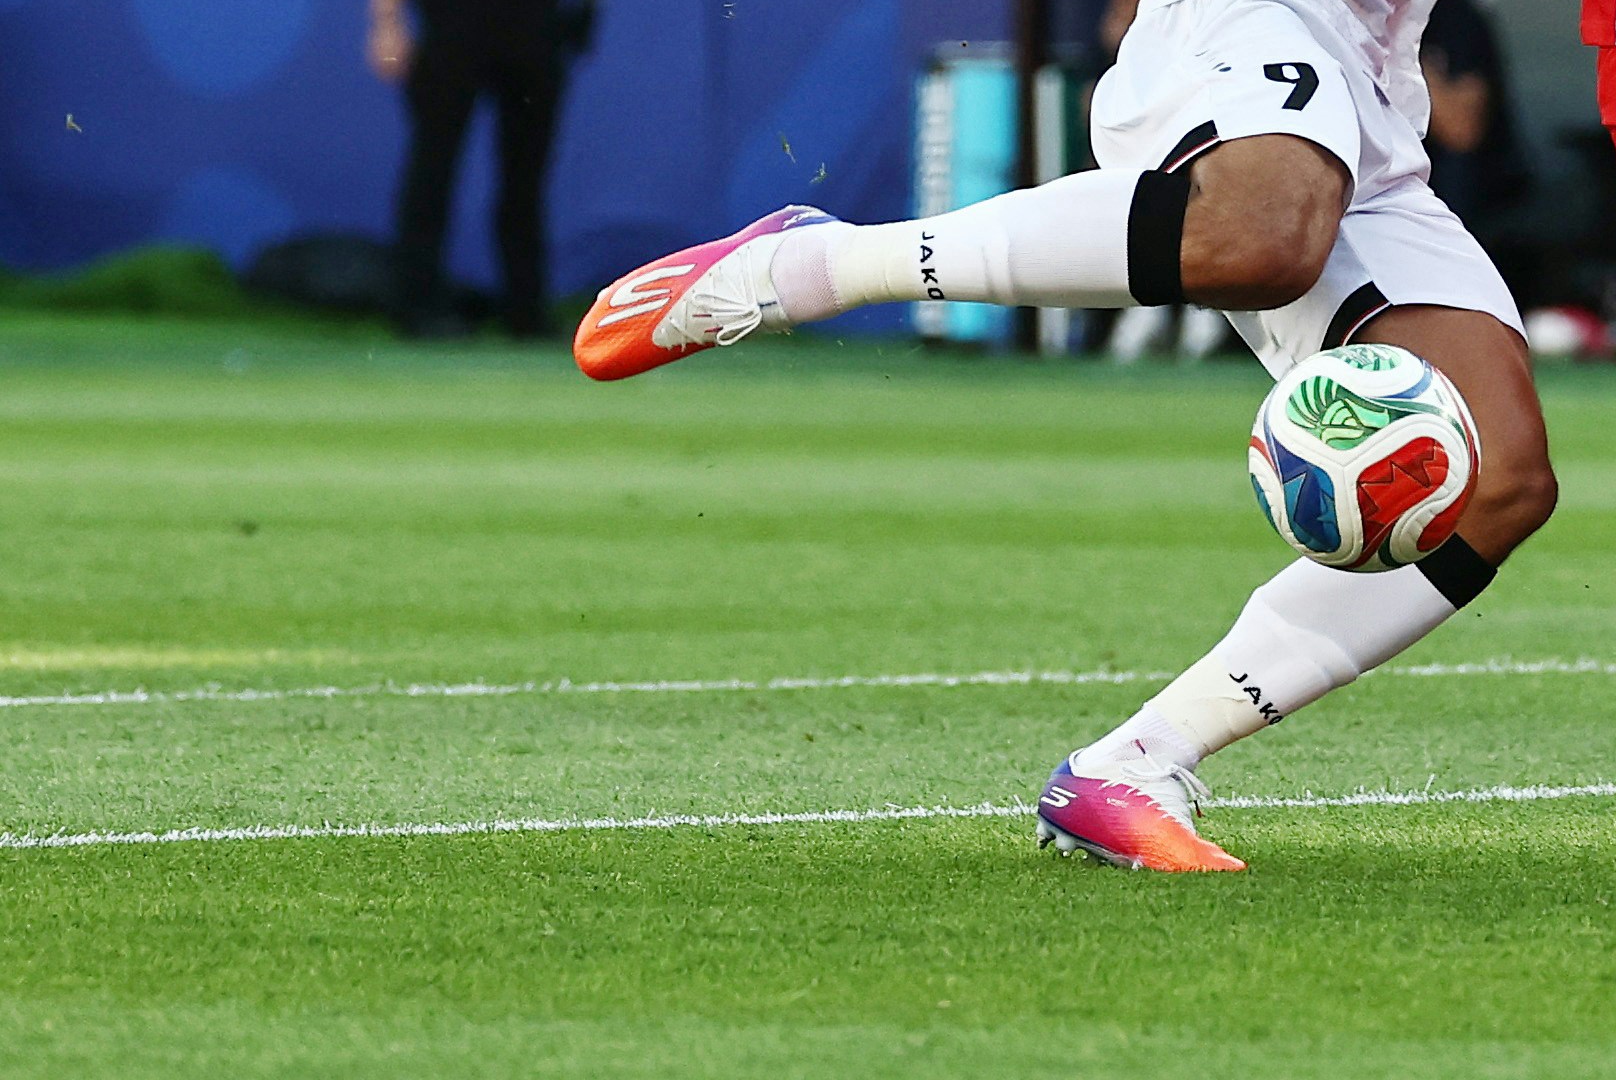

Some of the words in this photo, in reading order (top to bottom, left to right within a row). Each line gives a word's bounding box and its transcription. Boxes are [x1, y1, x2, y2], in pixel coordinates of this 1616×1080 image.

[1263, 62, 1319, 111] 9
[920, 231, 945, 300] JAKO
[1229, 673, 1283, 725] JAKO
